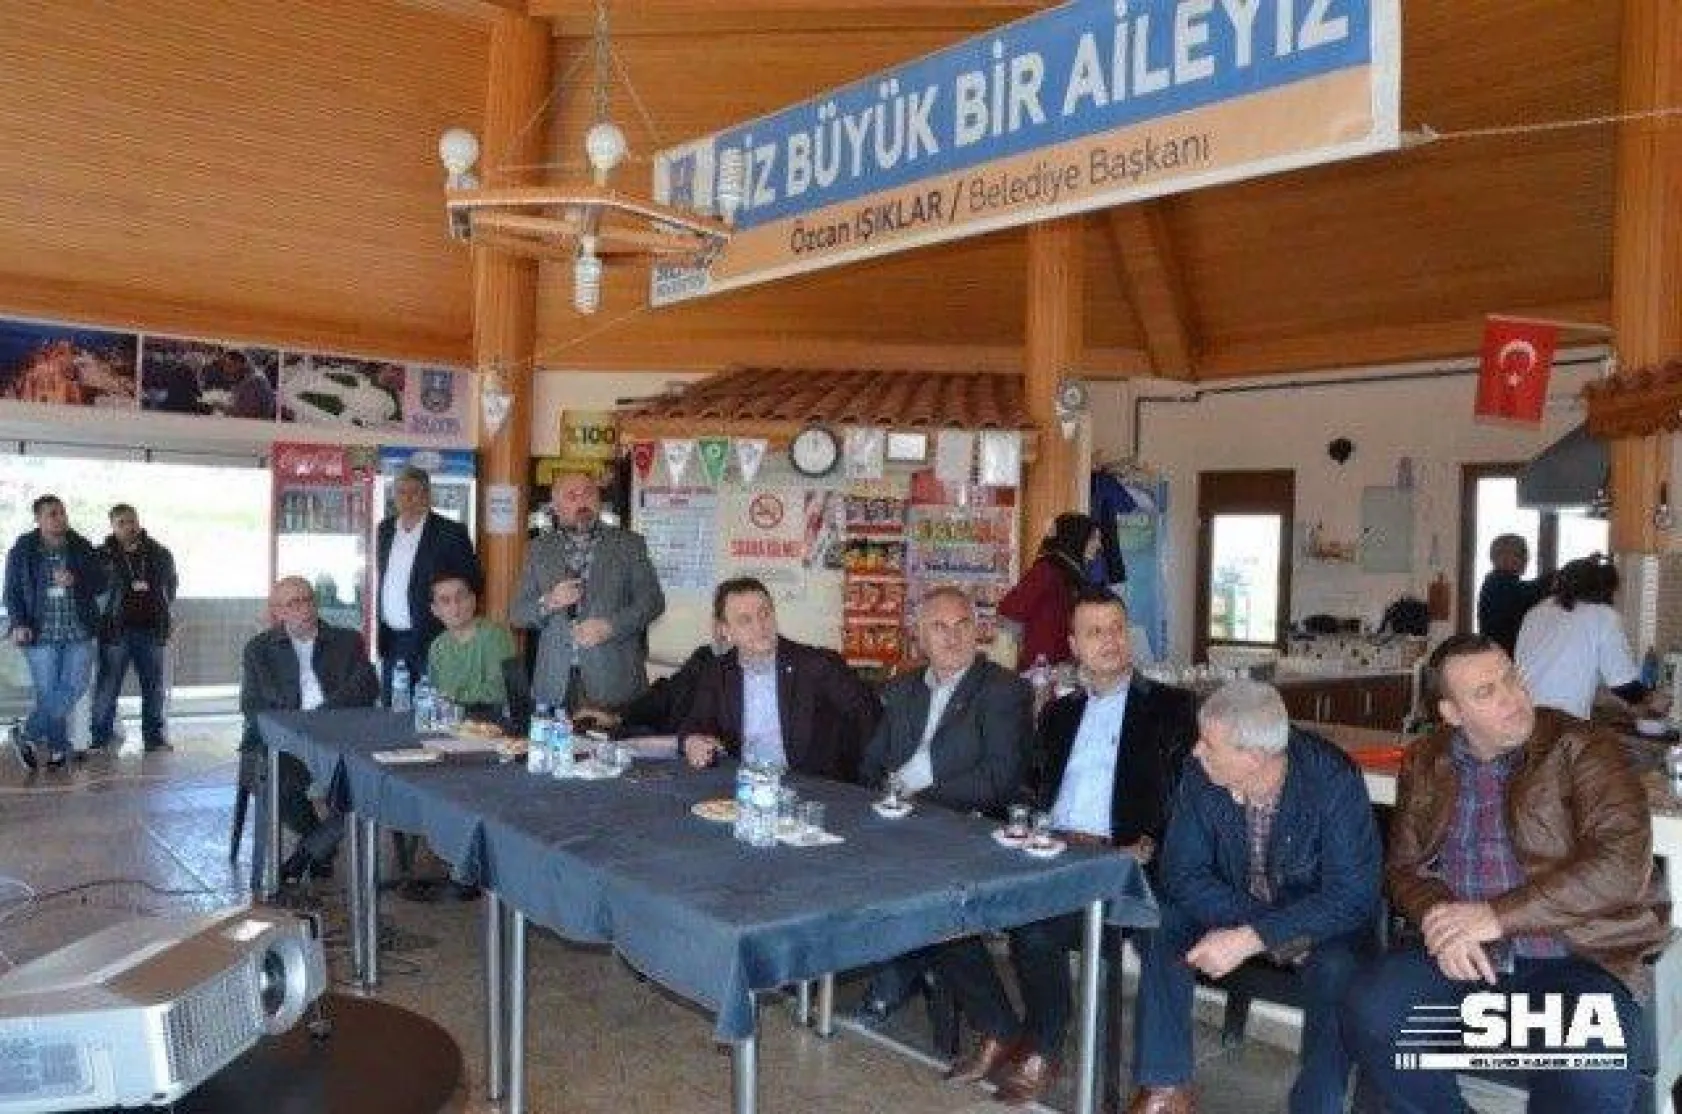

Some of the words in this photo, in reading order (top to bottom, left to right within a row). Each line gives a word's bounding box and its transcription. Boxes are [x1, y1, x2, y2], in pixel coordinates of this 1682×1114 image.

[787, 78, 940, 198] BÜYÜK
[953, 40, 1048, 148] BİR
[790, 218, 850, 253] Özcan
[855, 190, 942, 241] IŞIKLAR
[948, 179, 963, 222] /
[968, 162, 1080, 212] Belediye
[1089, 132, 1210, 186] Başkanı
